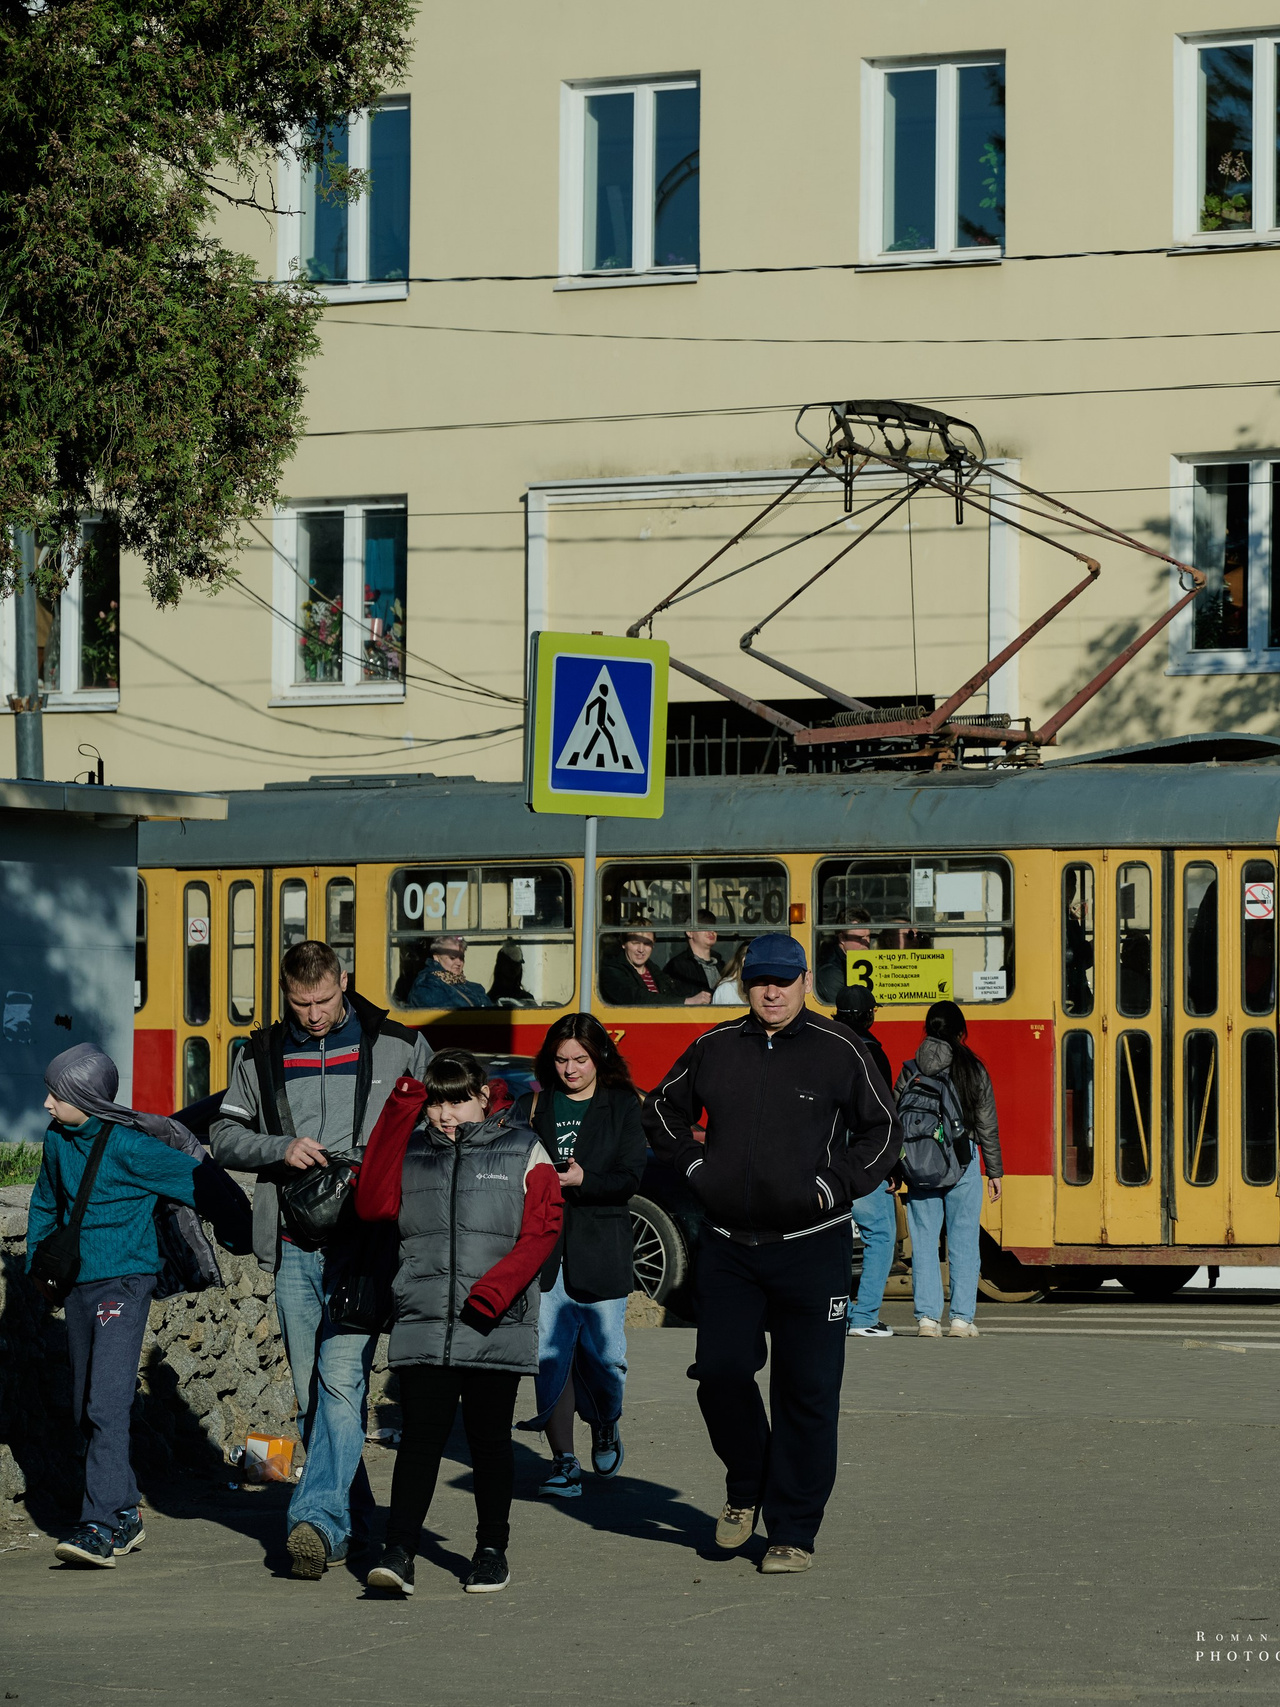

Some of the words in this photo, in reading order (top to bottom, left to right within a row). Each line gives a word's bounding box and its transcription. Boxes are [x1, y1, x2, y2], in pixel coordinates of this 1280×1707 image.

[403, 881, 468, 920] 037
[878, 953, 896, 961] к-цо
[897, 954, 909, 962] ул.
[910, 952, 945, 962] Пушкина
[852, 959, 874, 993] 3
[879, 992, 897, 1001] к-цо
[898, 991, 937, 999] ХИММАШ
[483, 1173, 509, 1181] Columbia
